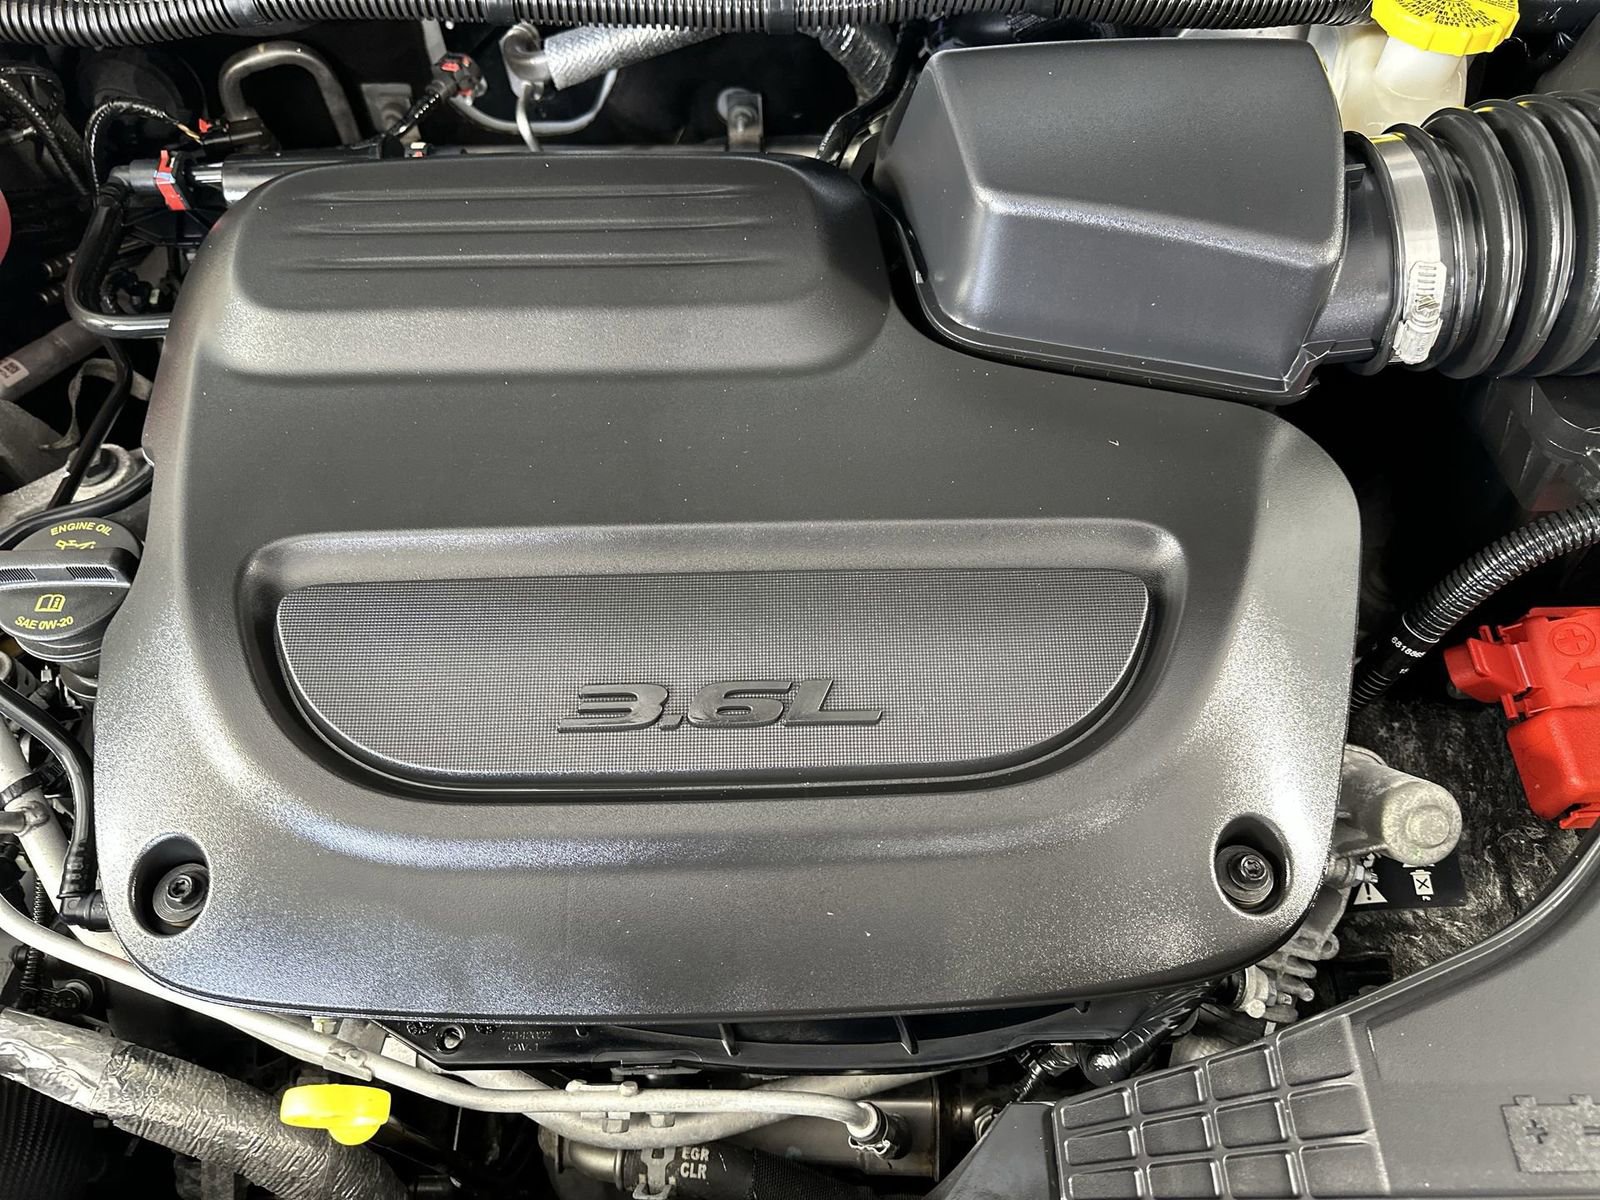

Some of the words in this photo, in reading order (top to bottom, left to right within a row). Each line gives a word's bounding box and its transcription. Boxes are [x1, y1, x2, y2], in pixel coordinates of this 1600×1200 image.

[50, 521, 96, 536] ENGINE
[95, 523, 113, 536] OIL
[15, 615, 37, 630] SAE
[38, 615, 74, 630] 0W-20
[557, 679, 882, 733] 3.6L
[681, 1146, 710, 1162] EGR
[680, 1162, 707, 1180] CLR
